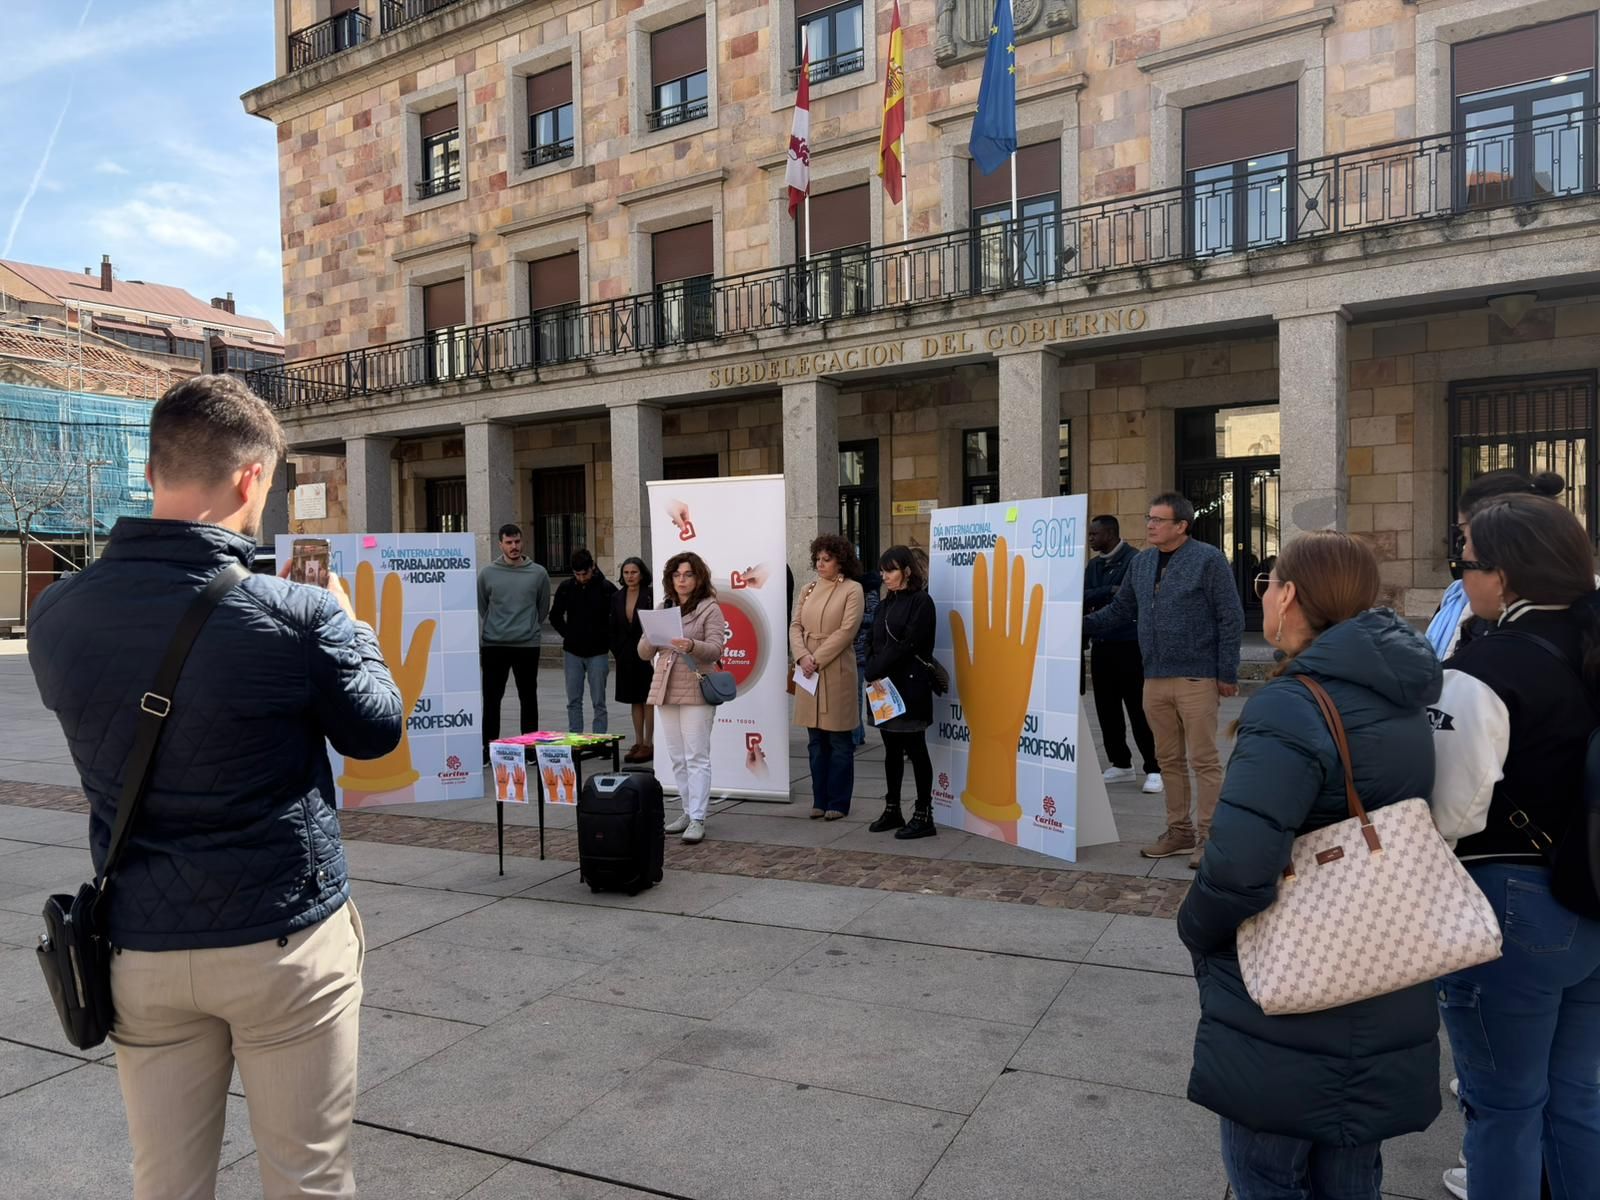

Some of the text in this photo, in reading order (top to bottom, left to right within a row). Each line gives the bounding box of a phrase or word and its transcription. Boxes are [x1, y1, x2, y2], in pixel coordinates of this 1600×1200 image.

[709, 307, 1146, 388] SUBDELEGACION DEL GOBIERNO
[944, 521, 992, 535] INTERNACIONAL
[939, 534, 997, 551] TRABAJADORAS
[1032, 517, 1076, 558] 30M
[381, 547, 463, 558] DÍA INTERNACIONAL
[390, 558, 471, 570] TRABAJADORAS
[410, 571, 445, 583] HOGAR
[414, 699, 431, 713] SU
[950, 704, 962, 721] TU
[406, 709, 473, 730] PROFESIÓN
[1024, 715, 1038, 733] SU
[939, 723, 970, 742] HOGAR
[1018, 737, 1075, 762] PROFESIÓN
